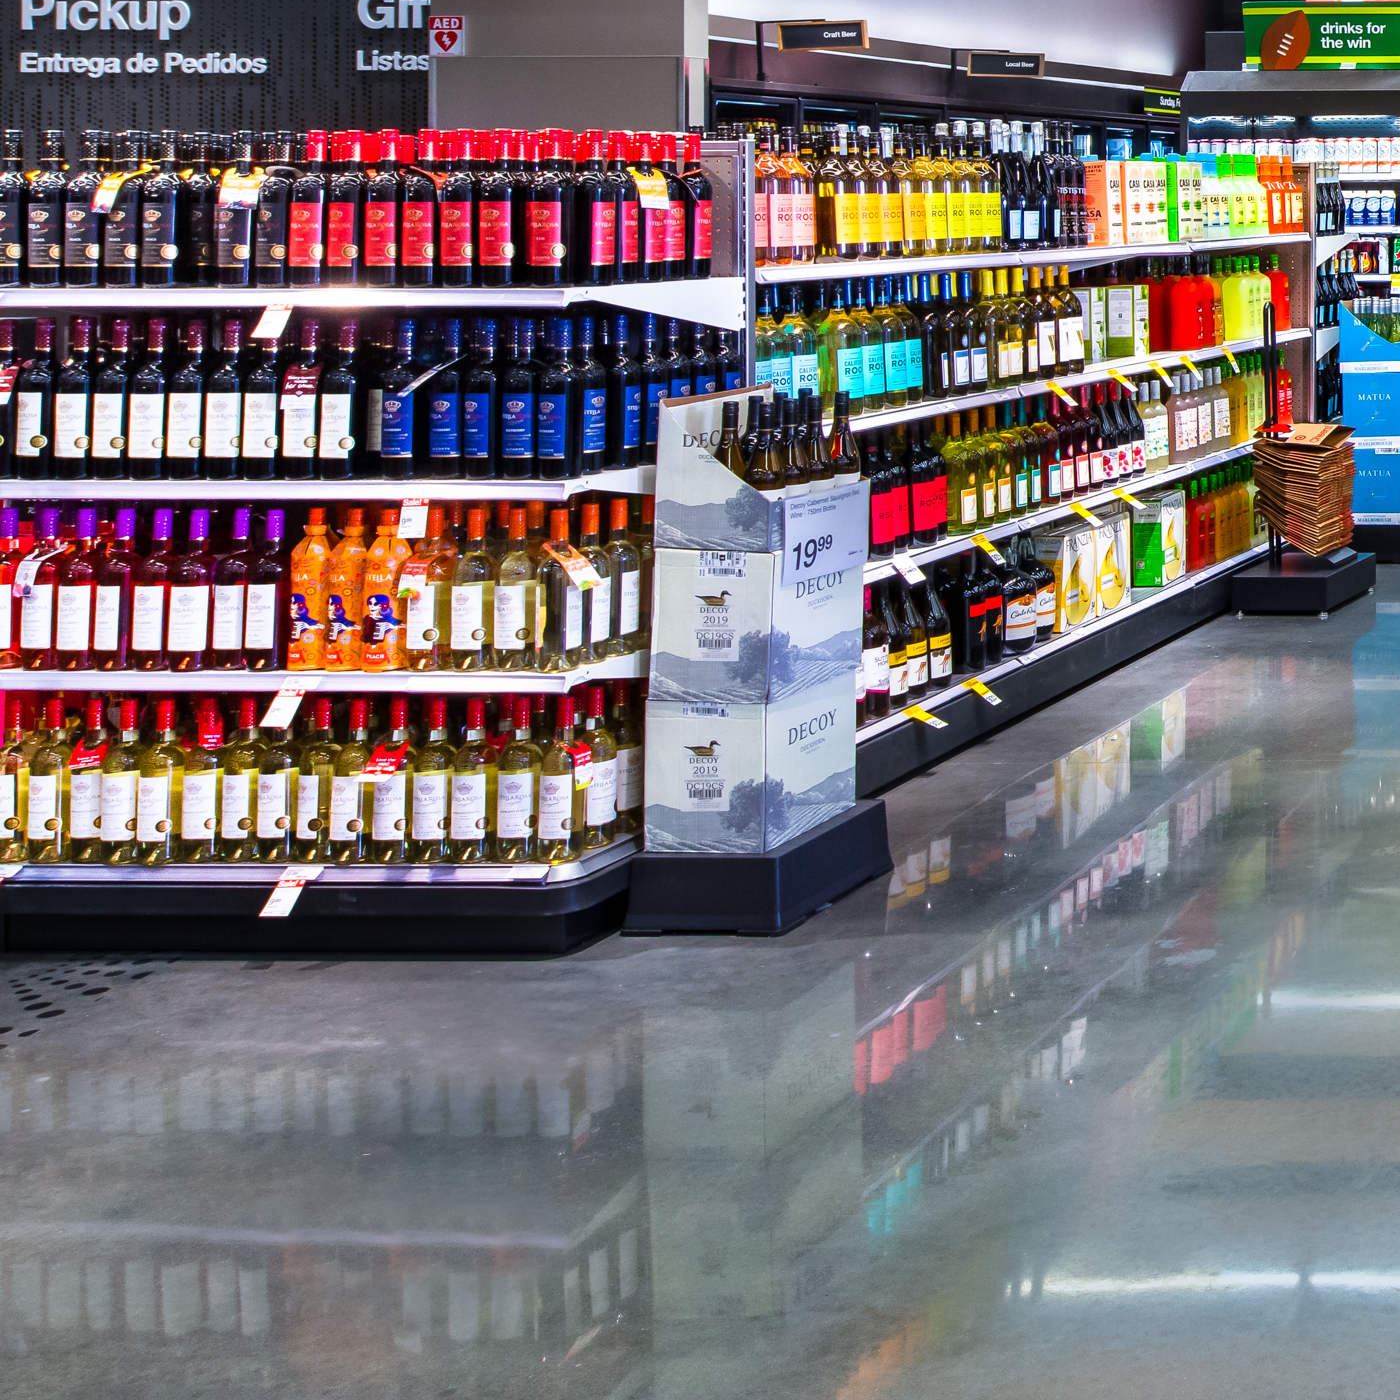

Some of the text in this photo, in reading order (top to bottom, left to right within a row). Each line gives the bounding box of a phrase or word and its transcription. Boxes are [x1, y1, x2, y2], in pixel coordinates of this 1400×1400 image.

[433, 18, 460, 30] AED
[1320, 22, 1387, 35] drinks for
[823, 30, 857, 39] Craft Beer
[1320, 37, 1371, 49] the win
[20, 52, 268, 78] Entrega de Pedidos
[356, 50, 429, 72] Listas
[1358, 393, 1391, 401] MATUA
[1309, 425, 1333, 443] Cheers!
[1358, 470, 1391, 478] MATUA
[403, 498, 422, 507] Sale!
[790, 489, 860, 511] Decoy Cabernet Sauvignon Red
[807, 508, 821, 516] 750ml
[822, 504, 837, 513] Bottle
[1099, 519, 1126, 540] FRANZIA
[1066, 531, 1092, 552] FRANZIA
[796, 570, 844, 599] DECOY
[703, 616, 729, 624] 2019
[696, 631, 734, 640] DC19CS
[874, 653, 888, 664] SUTT
[278, 689, 298, 697] Sale!
[787, 708, 838, 746] DECOY
[689, 756, 719, 764] DECOY
[692, 766, 718, 775] 2019
[686, 782, 725, 790] DC19CS
[278, 880, 298, 888] Sale!
